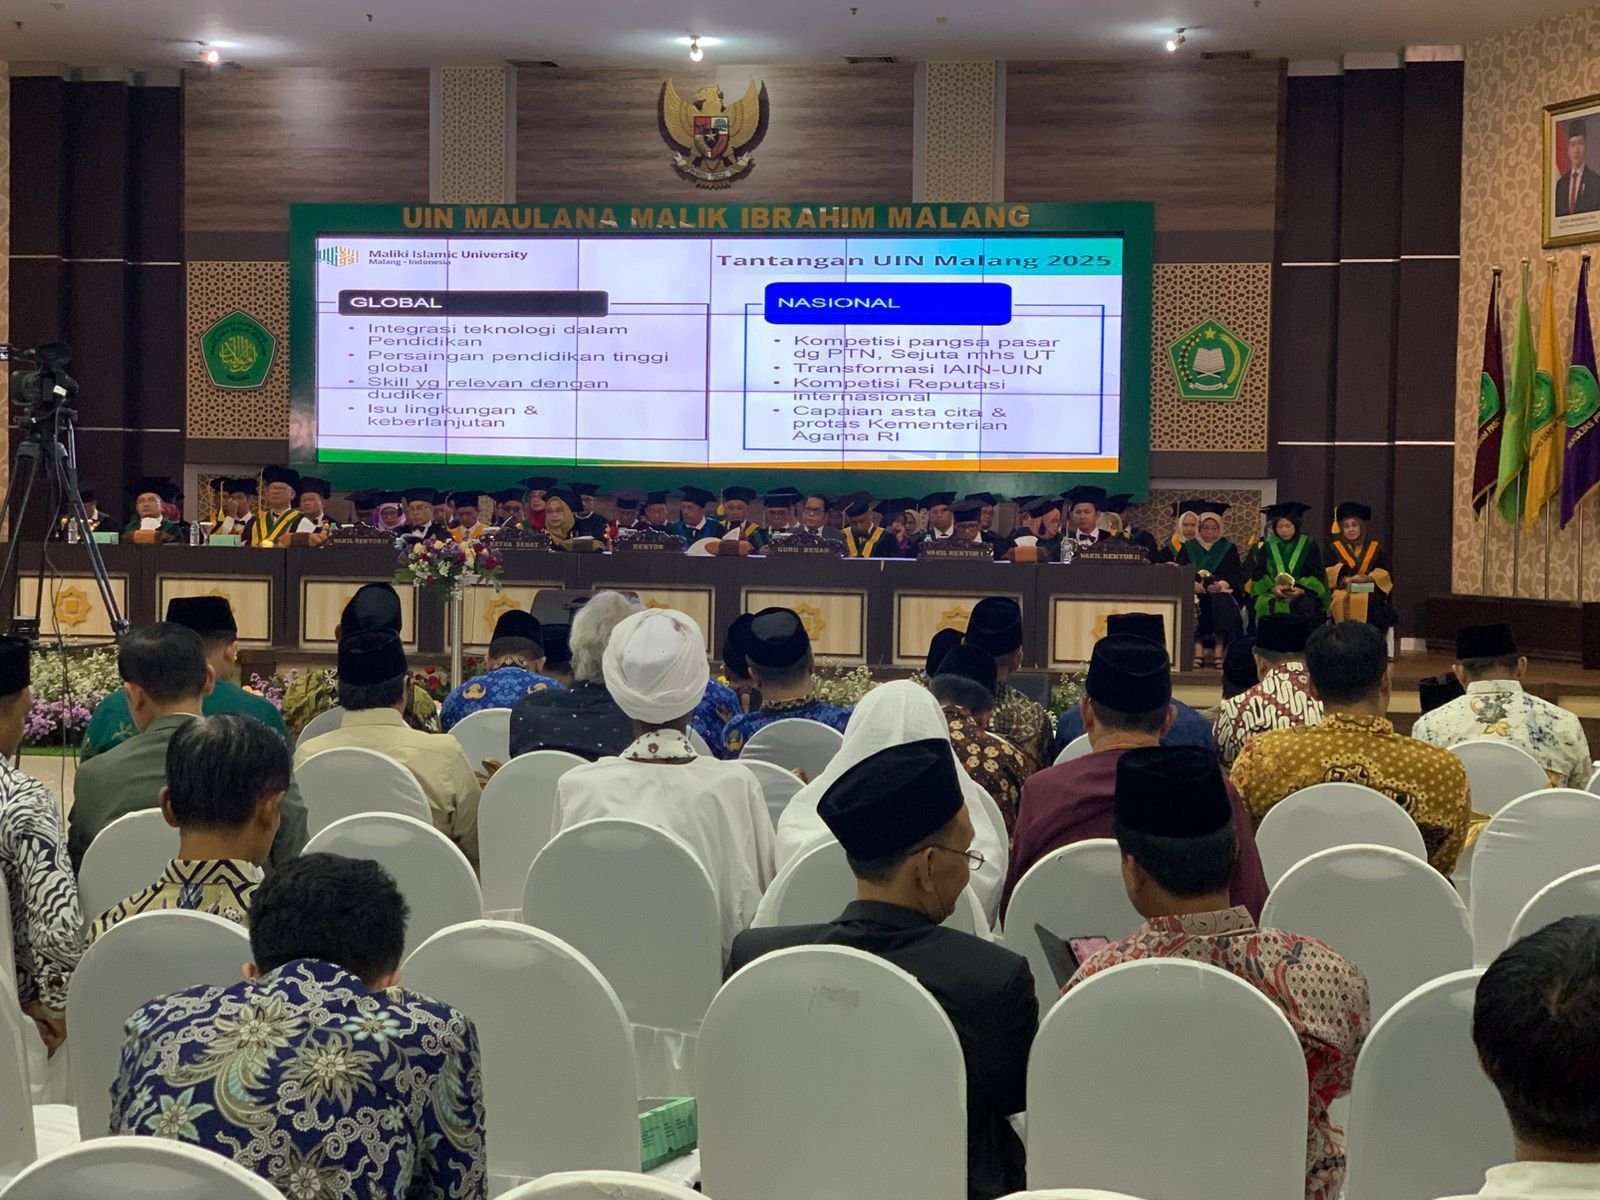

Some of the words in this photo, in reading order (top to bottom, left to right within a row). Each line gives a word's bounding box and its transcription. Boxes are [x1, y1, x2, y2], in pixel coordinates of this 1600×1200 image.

[403, 207, 453, 229] UIN
[465, 207, 618, 229] MAULANA
[631, 207, 728, 229] MALIK
[741, 206, 875, 229] IBRAHIM
[888, 205, 1030, 228] MALANG
[368, 249, 409, 258] Maliki
[412, 249, 458, 258] Islamic
[461, 250, 528, 261] University
[368, 258, 402, 266] Malang
[716, 254, 864, 270] Tantangan
[874, 254, 924, 266] UIN
[934, 254, 1038, 269] Malang
[1046, 255, 1111, 266] 2025
[350, 297, 443, 308] GLOBAL
[778, 298, 901, 308] NASIONAL
[368, 323, 456, 336] Integrasi
[464, 324, 556, 336] teknologi
[563, 324, 628, 335] dalam
[368, 336, 482, 347] Pendidikan
[794, 336, 900, 348] Kompetisi
[909, 337, 990, 349] pangsa
[998, 339, 1060, 350] pasar
[368, 350, 484, 363] Persaingan
[492, 351, 605, 364] pendidikan
[613, 352, 669, 364] tinggi
[794, 349, 820, 360] dg
[828, 348, 882, 360] PTN,
[891, 349, 959, 361] Sejuta
[967, 349, 1015, 360] mhs
[1023, 350, 1056, 360] UT
[367, 363, 428, 375] global
[794, 362, 934, 374] Transformasi
[943, 364, 1042, 375] IAIN-UIN
[367, 376, 409, 387] Skill
[416, 379, 440, 390] yg
[448, 378, 522, 388] relevan
[530, 378, 609, 391] dengan
[794, 377, 900, 390] Kompetisi
[908, 378, 1006, 391] Reputasi
[367, 389, 443, 400] dudiker
[793, 391, 930, 402] internasional
[368, 403, 397, 414] Isu
[405, 404, 515, 417] lingkungan
[524, 405, 539, 415] &
[793, 405, 882, 418] Capaian
[891, 406, 936, 417] asta
[944, 406, 983, 417] cita
[991, 407, 1007, 417] &
[368, 416, 505, 429] keberlanjutan
[793, 418, 860, 431] protas
[868, 418, 1008, 430] Kementerian
[792, 430, 869, 443] Agama
[878, 431, 900, 442] RI
